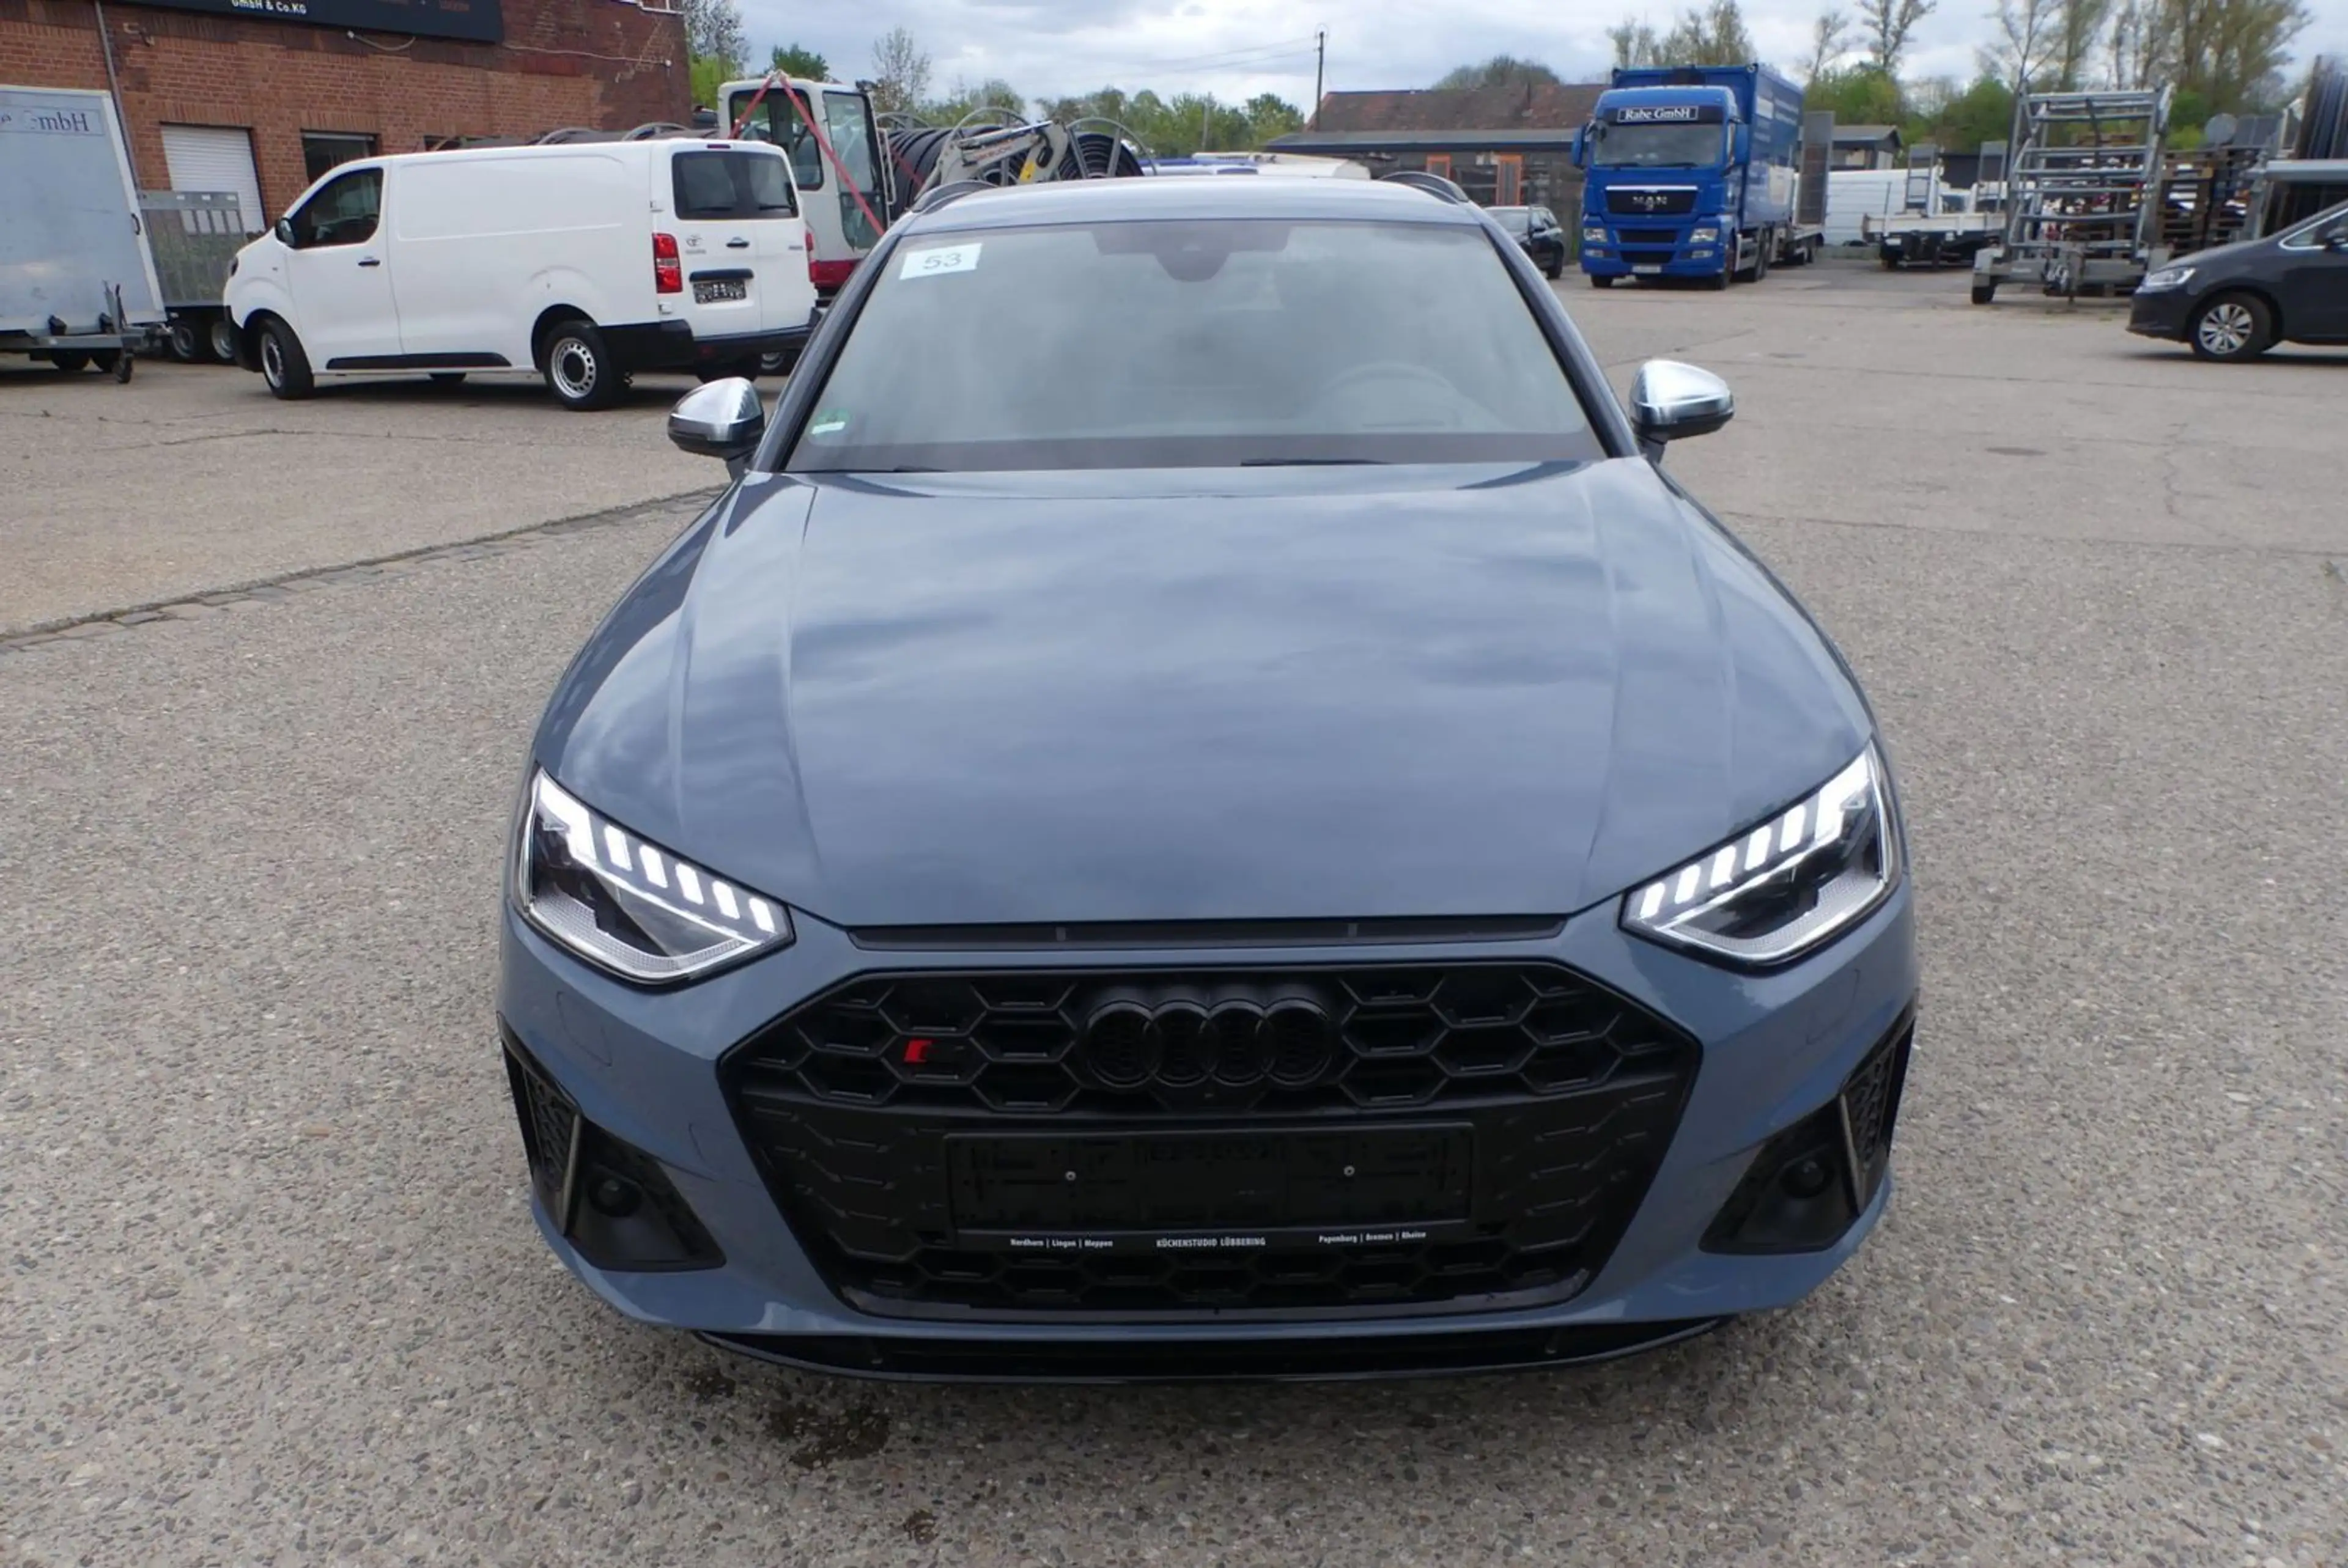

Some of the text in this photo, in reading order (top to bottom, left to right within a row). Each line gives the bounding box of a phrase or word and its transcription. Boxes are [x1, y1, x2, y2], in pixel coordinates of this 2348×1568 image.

[266, 1, 273, 10] &
[24, 111, 90, 131] mbH
[923, 252, 962, 270] 53
[1156, 1236, 1266, 1248] KÜCHENSTUDIO LÜBBERING
